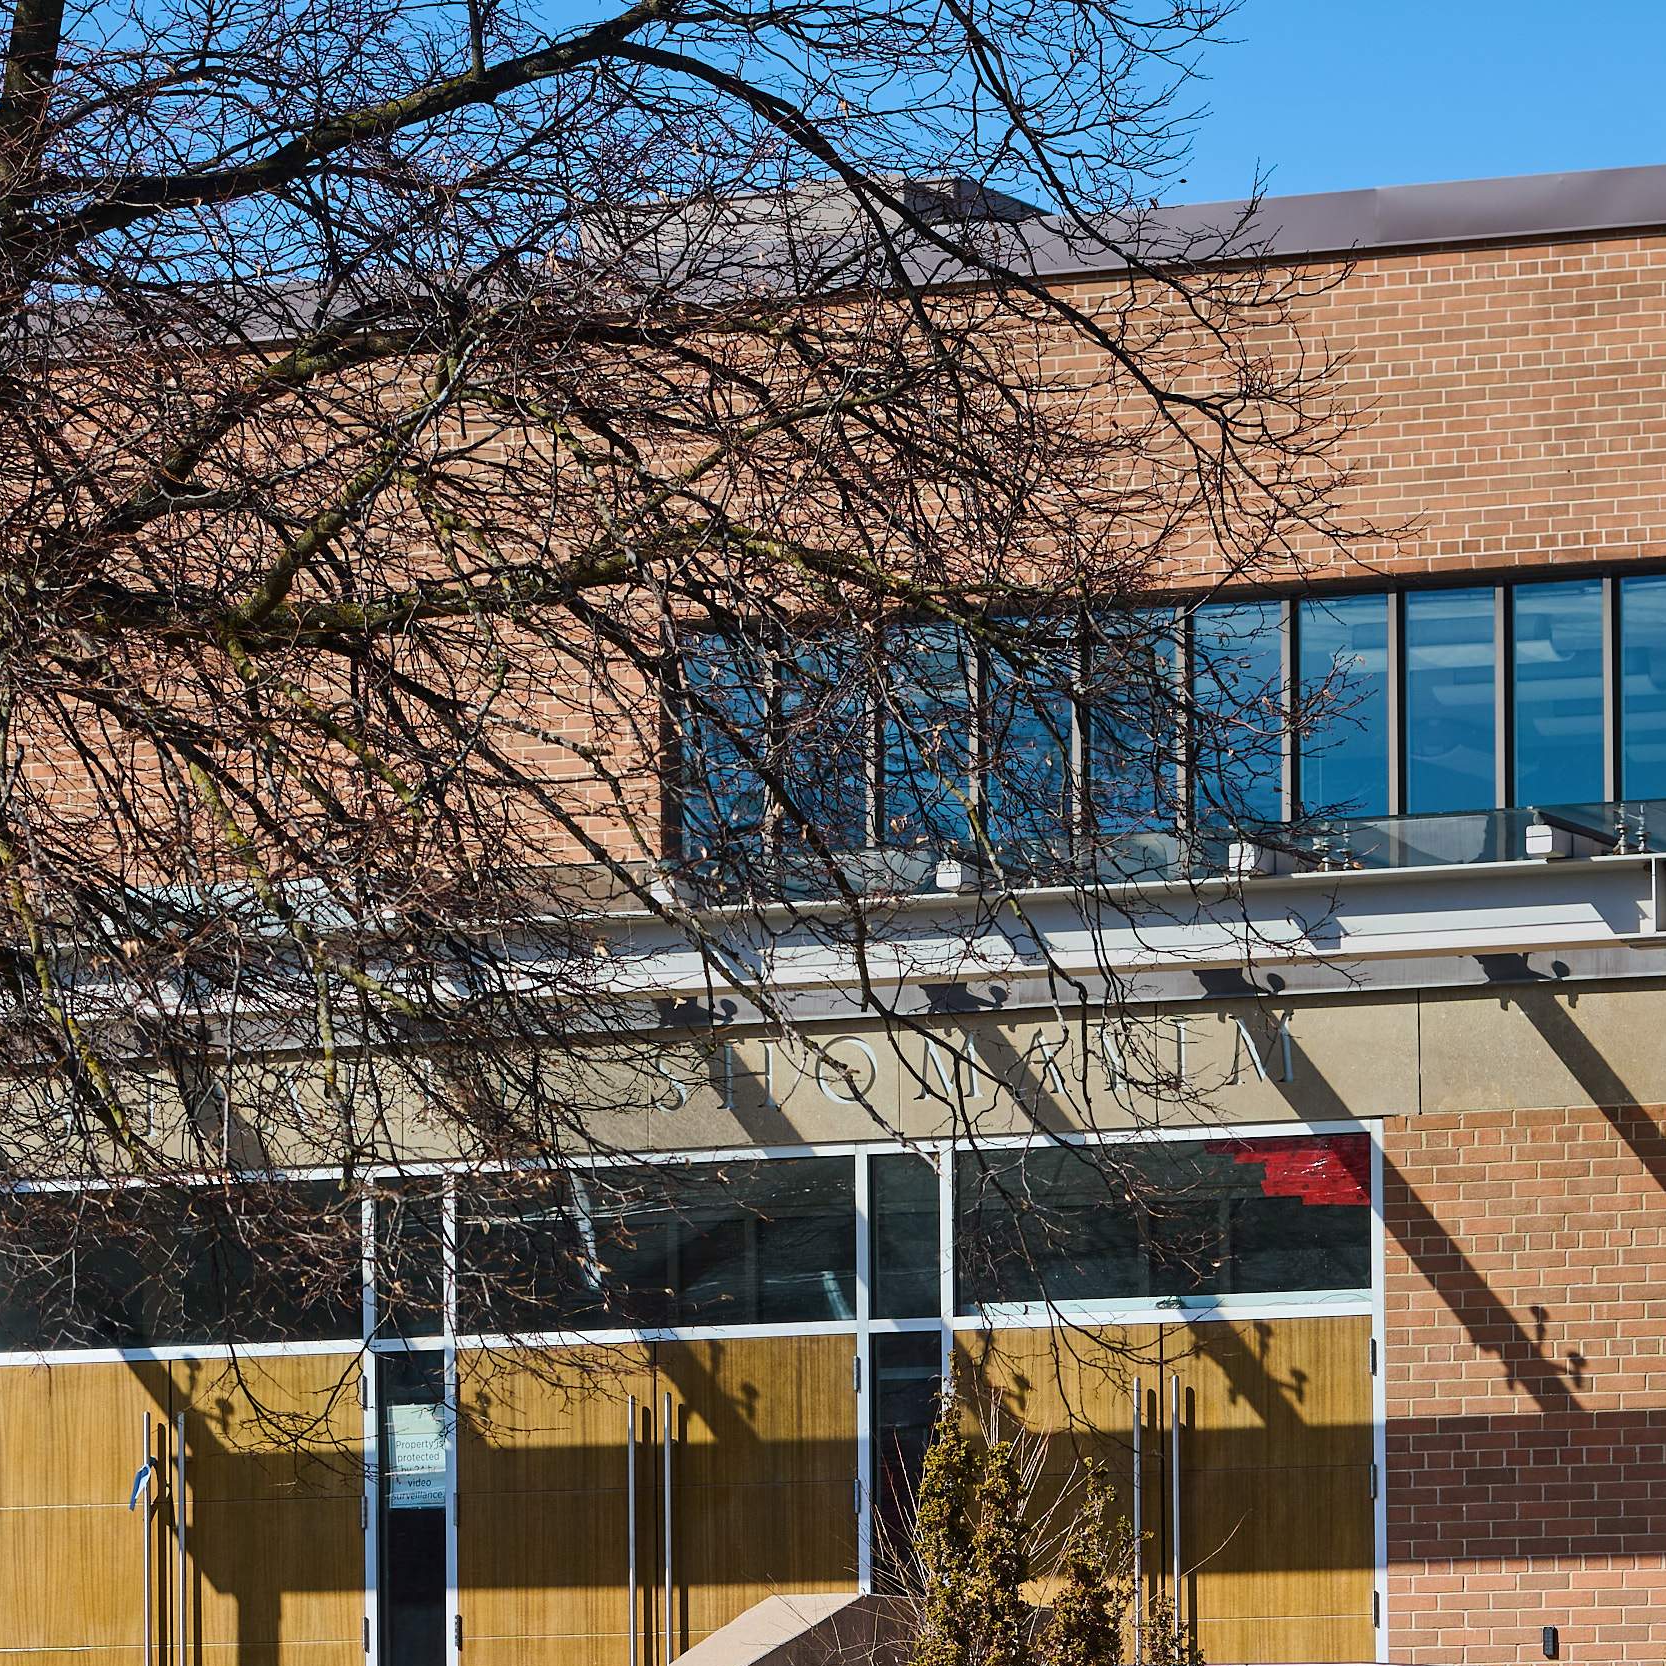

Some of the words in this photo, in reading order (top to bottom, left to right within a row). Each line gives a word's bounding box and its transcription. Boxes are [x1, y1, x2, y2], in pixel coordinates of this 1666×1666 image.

[396, 1440, 433, 1450] Property
[398, 1452, 440, 1463] protected
[408, 1478, 432, 1487] video
